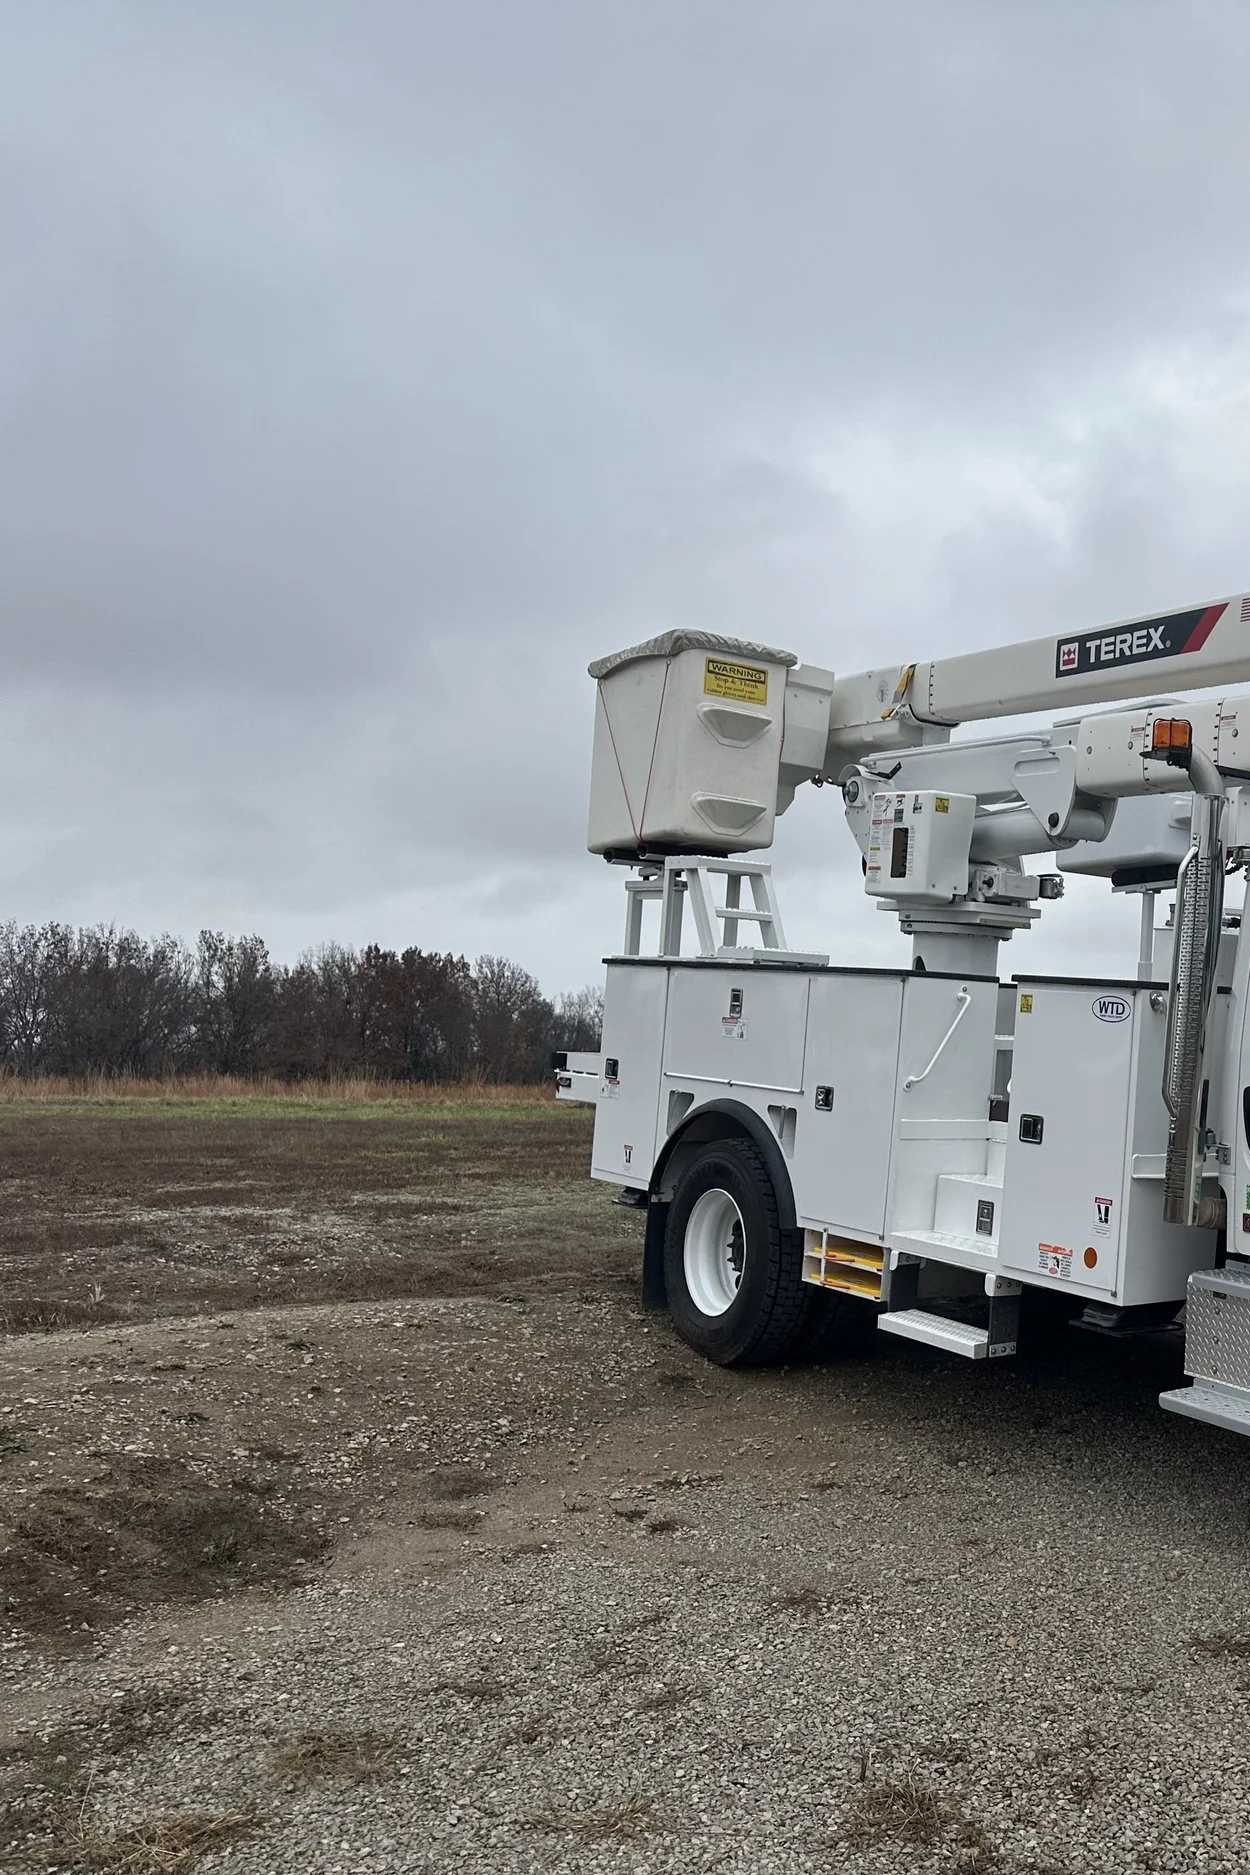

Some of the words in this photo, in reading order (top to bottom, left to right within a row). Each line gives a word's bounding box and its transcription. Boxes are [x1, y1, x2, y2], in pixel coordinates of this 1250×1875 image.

[711, 663, 762, 680] WARNING
[714, 675, 729, 685] Stop
[739, 680, 759, 689] Think
[1098, 1000, 1125, 1015] WTD
